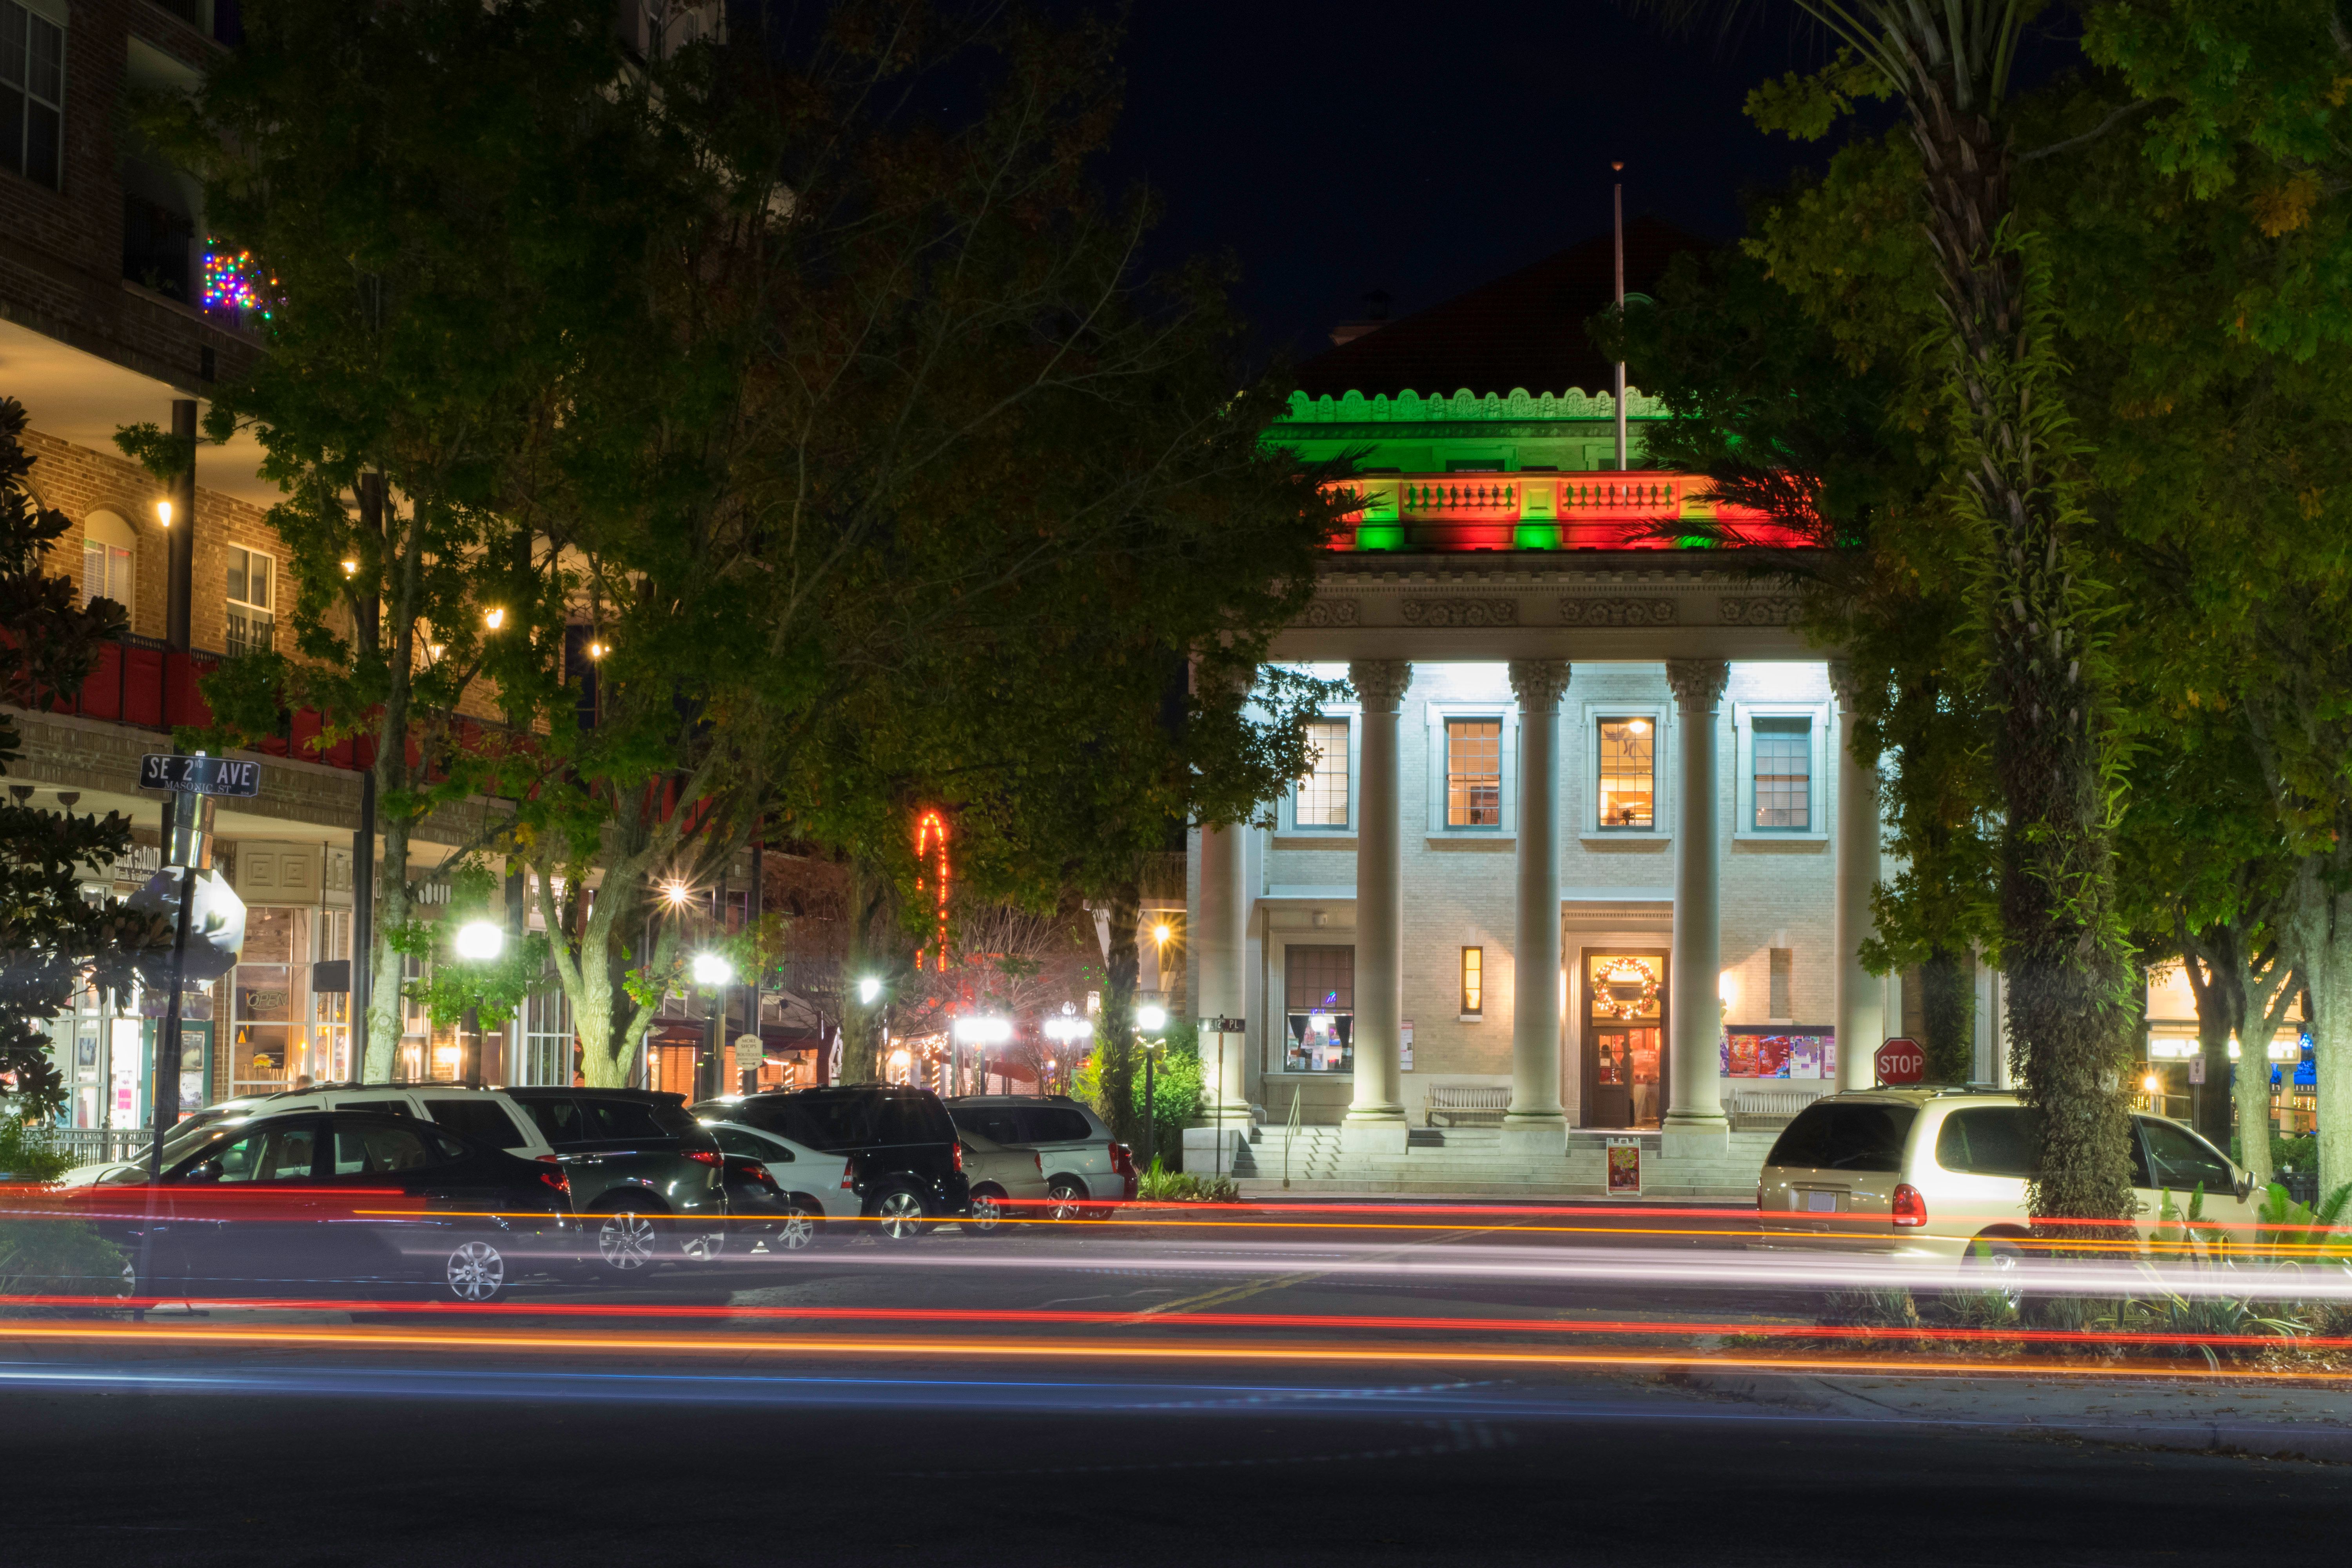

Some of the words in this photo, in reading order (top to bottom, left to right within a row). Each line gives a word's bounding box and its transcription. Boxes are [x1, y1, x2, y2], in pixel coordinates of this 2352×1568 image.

[149, 757, 171, 779] SE
[216, 762, 252, 786] AVE
[164, 780, 213, 792] MASONIC
[218, 785, 232, 794] ST
[247, 993, 287, 1006] OPEN
[1229, 1020, 1239, 1029] PL
[1880, 1055, 1923, 1073] STOP
